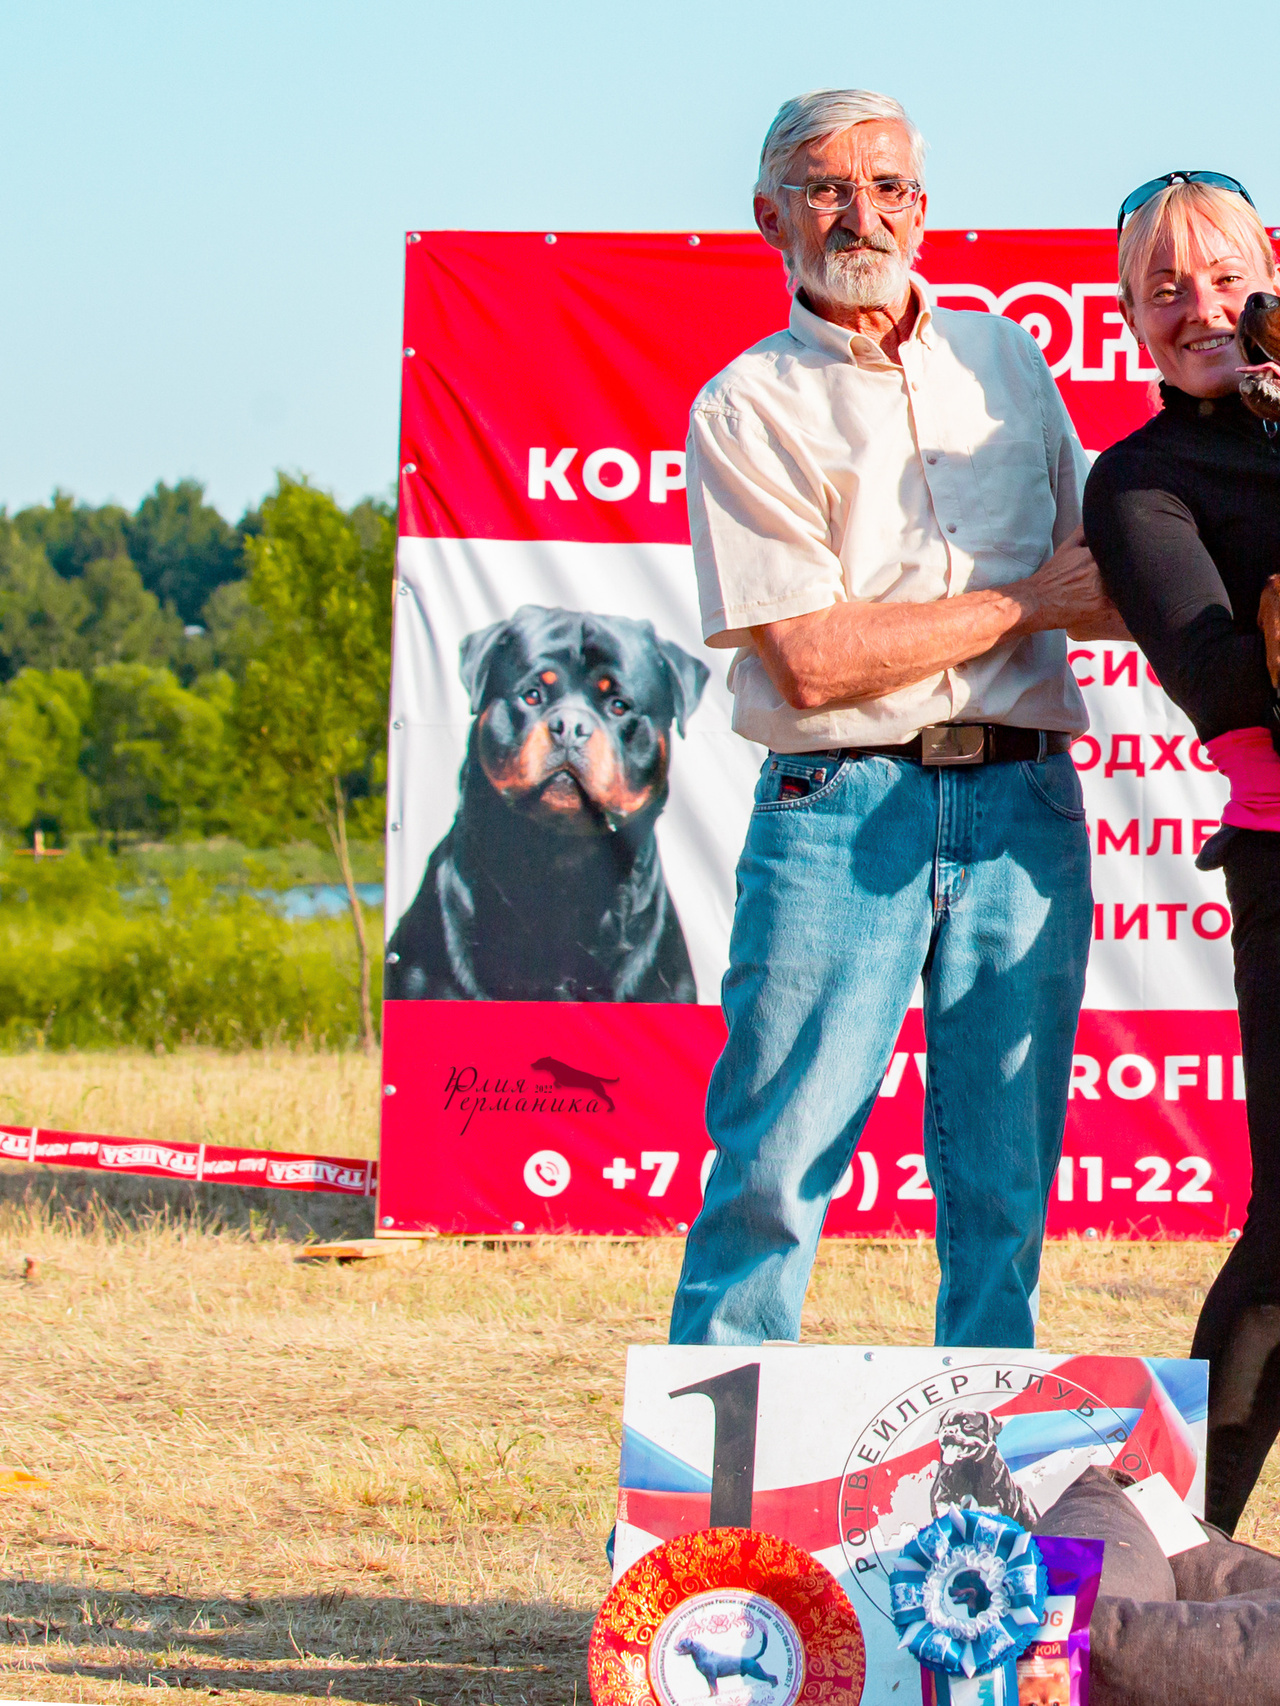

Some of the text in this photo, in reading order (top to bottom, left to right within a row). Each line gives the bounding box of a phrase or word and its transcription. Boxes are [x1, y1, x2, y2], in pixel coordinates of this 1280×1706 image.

[528, 447, 687, 503] КОР
[103, 1147, 196, 1171] ТРАПЕЗА
[271, 1163, 364, 1187] ТРАПЕЗА
[603, 1151, 679, 1197] +7
[668, 1362, 761, 1527] 1
[844, 1374, 969, 1574] РОТВЕЙЛЕР
[995, 1370, 1098, 1417] КЛУБ
